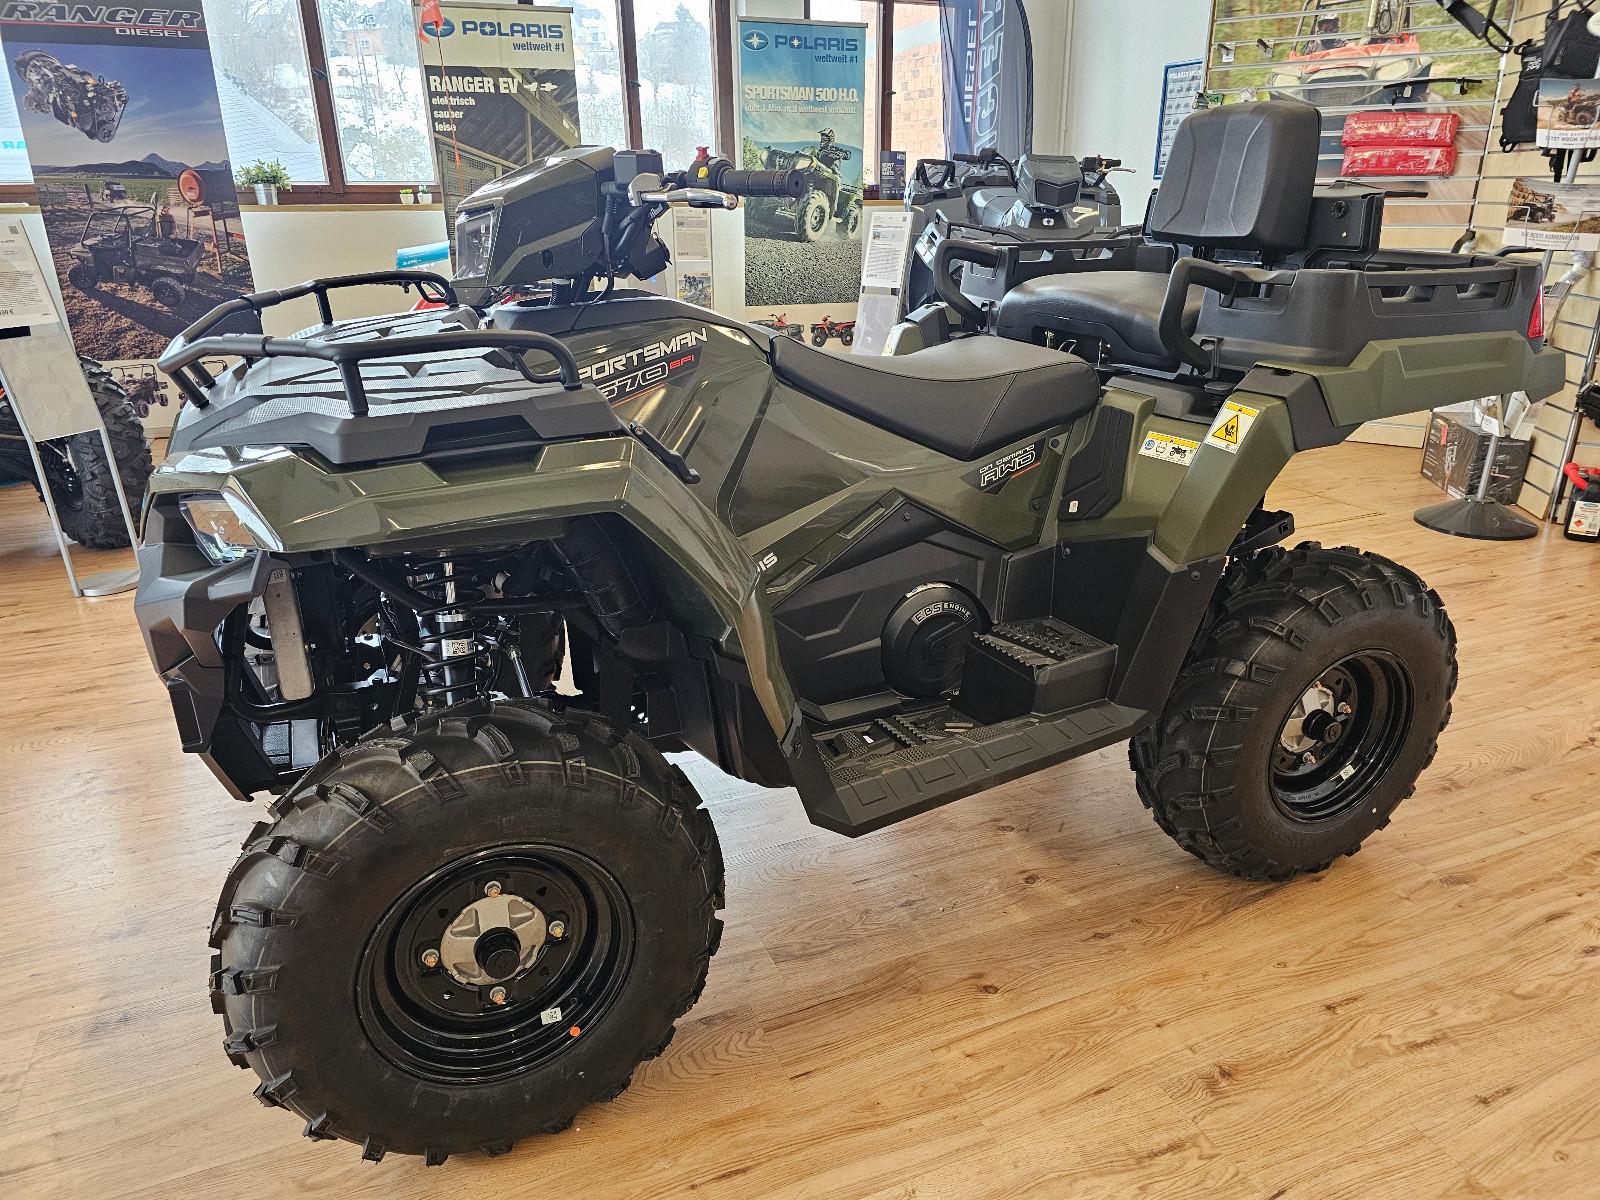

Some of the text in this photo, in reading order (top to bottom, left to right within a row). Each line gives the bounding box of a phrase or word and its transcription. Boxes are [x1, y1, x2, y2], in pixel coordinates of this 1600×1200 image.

[1, 2, 202, 28] RANGER
[115, 27, 190, 38] DIESEL
[461, 20, 564, 39] POLARIS
[512, 42, 565, 52] weltweit #1
[774, 34, 858, 52] POLARIS
[814, 54, 858, 63] weltweit #1
[963, 8, 977, 123] DIESEL
[429, 75, 519, 94] RANGER EV
[745, 84, 814, 102] SPORTSMAN
[815, 87, 837, 103] 500
[432, 96, 475, 106] elektrisch
[434, 110, 463, 119] sauber
[577, 327, 708, 381] PORTSMAN
[597, 354, 695, 399] 570 EFI
[980, 450, 1036, 487] AWD
[914, 602, 972, 624] EBS ENGINE
